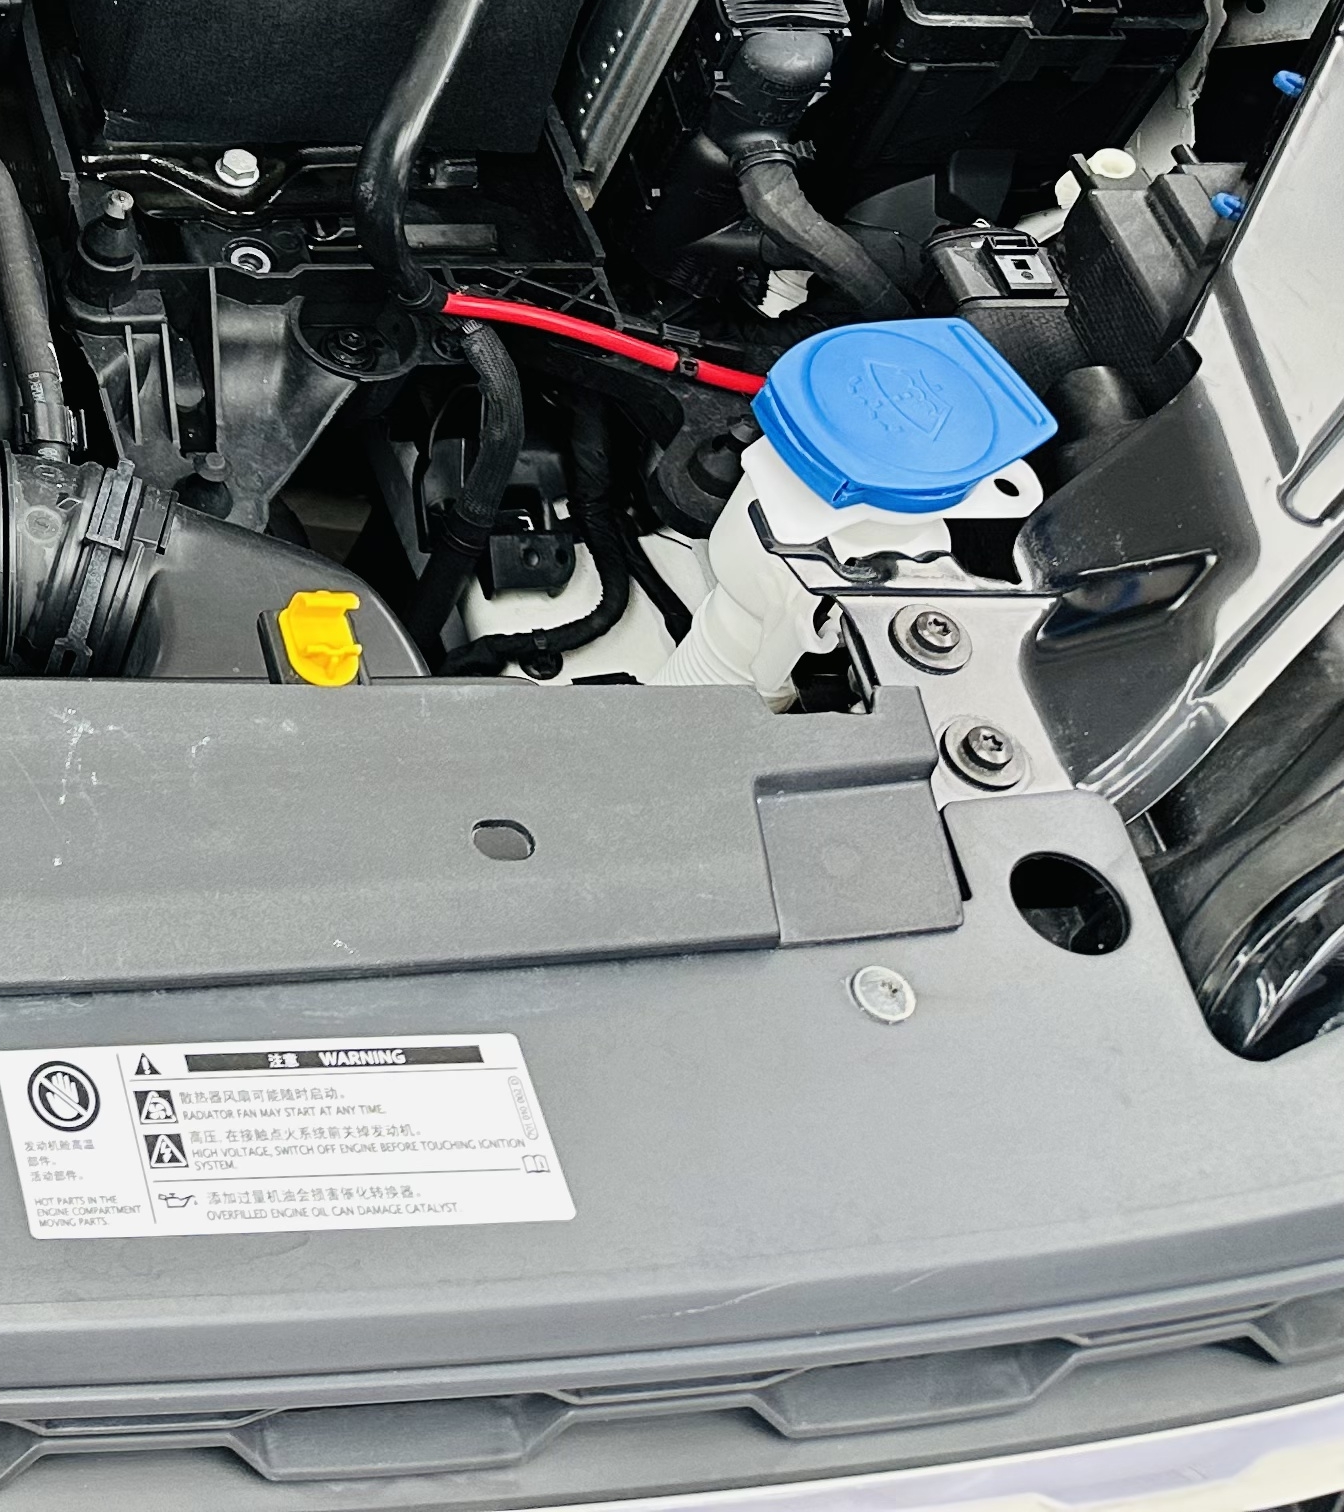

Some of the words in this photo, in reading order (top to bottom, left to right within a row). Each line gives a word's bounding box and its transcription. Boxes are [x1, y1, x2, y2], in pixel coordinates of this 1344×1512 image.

[267, 1053, 299, 1068] 注意
[319, 1047, 407, 1068] WARNING
[183, 1109, 234, 1121] RADIATOR
[237, 1109, 257, 1119] FAN
[260, 1108, 281, 1117] MAY
[285, 1107, 316, 1117] START
[320, 1106, 332, 1116] AT
[336, 1105, 356, 1115] ANY
[192, 1149, 218, 1158] HIGH
[222, 1147, 272, 1157] VOLTAGE,
[276, 1145, 313, 1155] SWITCH
[317, 1144, 336, 1154] OFF
[340, 1143, 378, 1155] ENGINE
[380, 1141, 419, 1153] BEFORE
[421, 1139, 477, 1151] TOUCHING
[479, 1138, 526, 1149] IGNITION
[35, 1198, 55, 1206] HOT
[57, 1197, 86, 1205] PARTS
[88, 1196, 97, 1204] IN
[37, 1208, 69, 1216] ENGINE
[72, 1205, 141, 1216] COMPARTMENT
[207, 1209, 267, 1220] OVERFILLED
[271, 1208, 309, 1218] ENGINE
[312, 1207, 327, 1217] OIL
[332, 1206, 354, 1216] CAN
[357, 1204, 402, 1216] DAMAGE
[39, 1218, 77, 1227] MOVING
